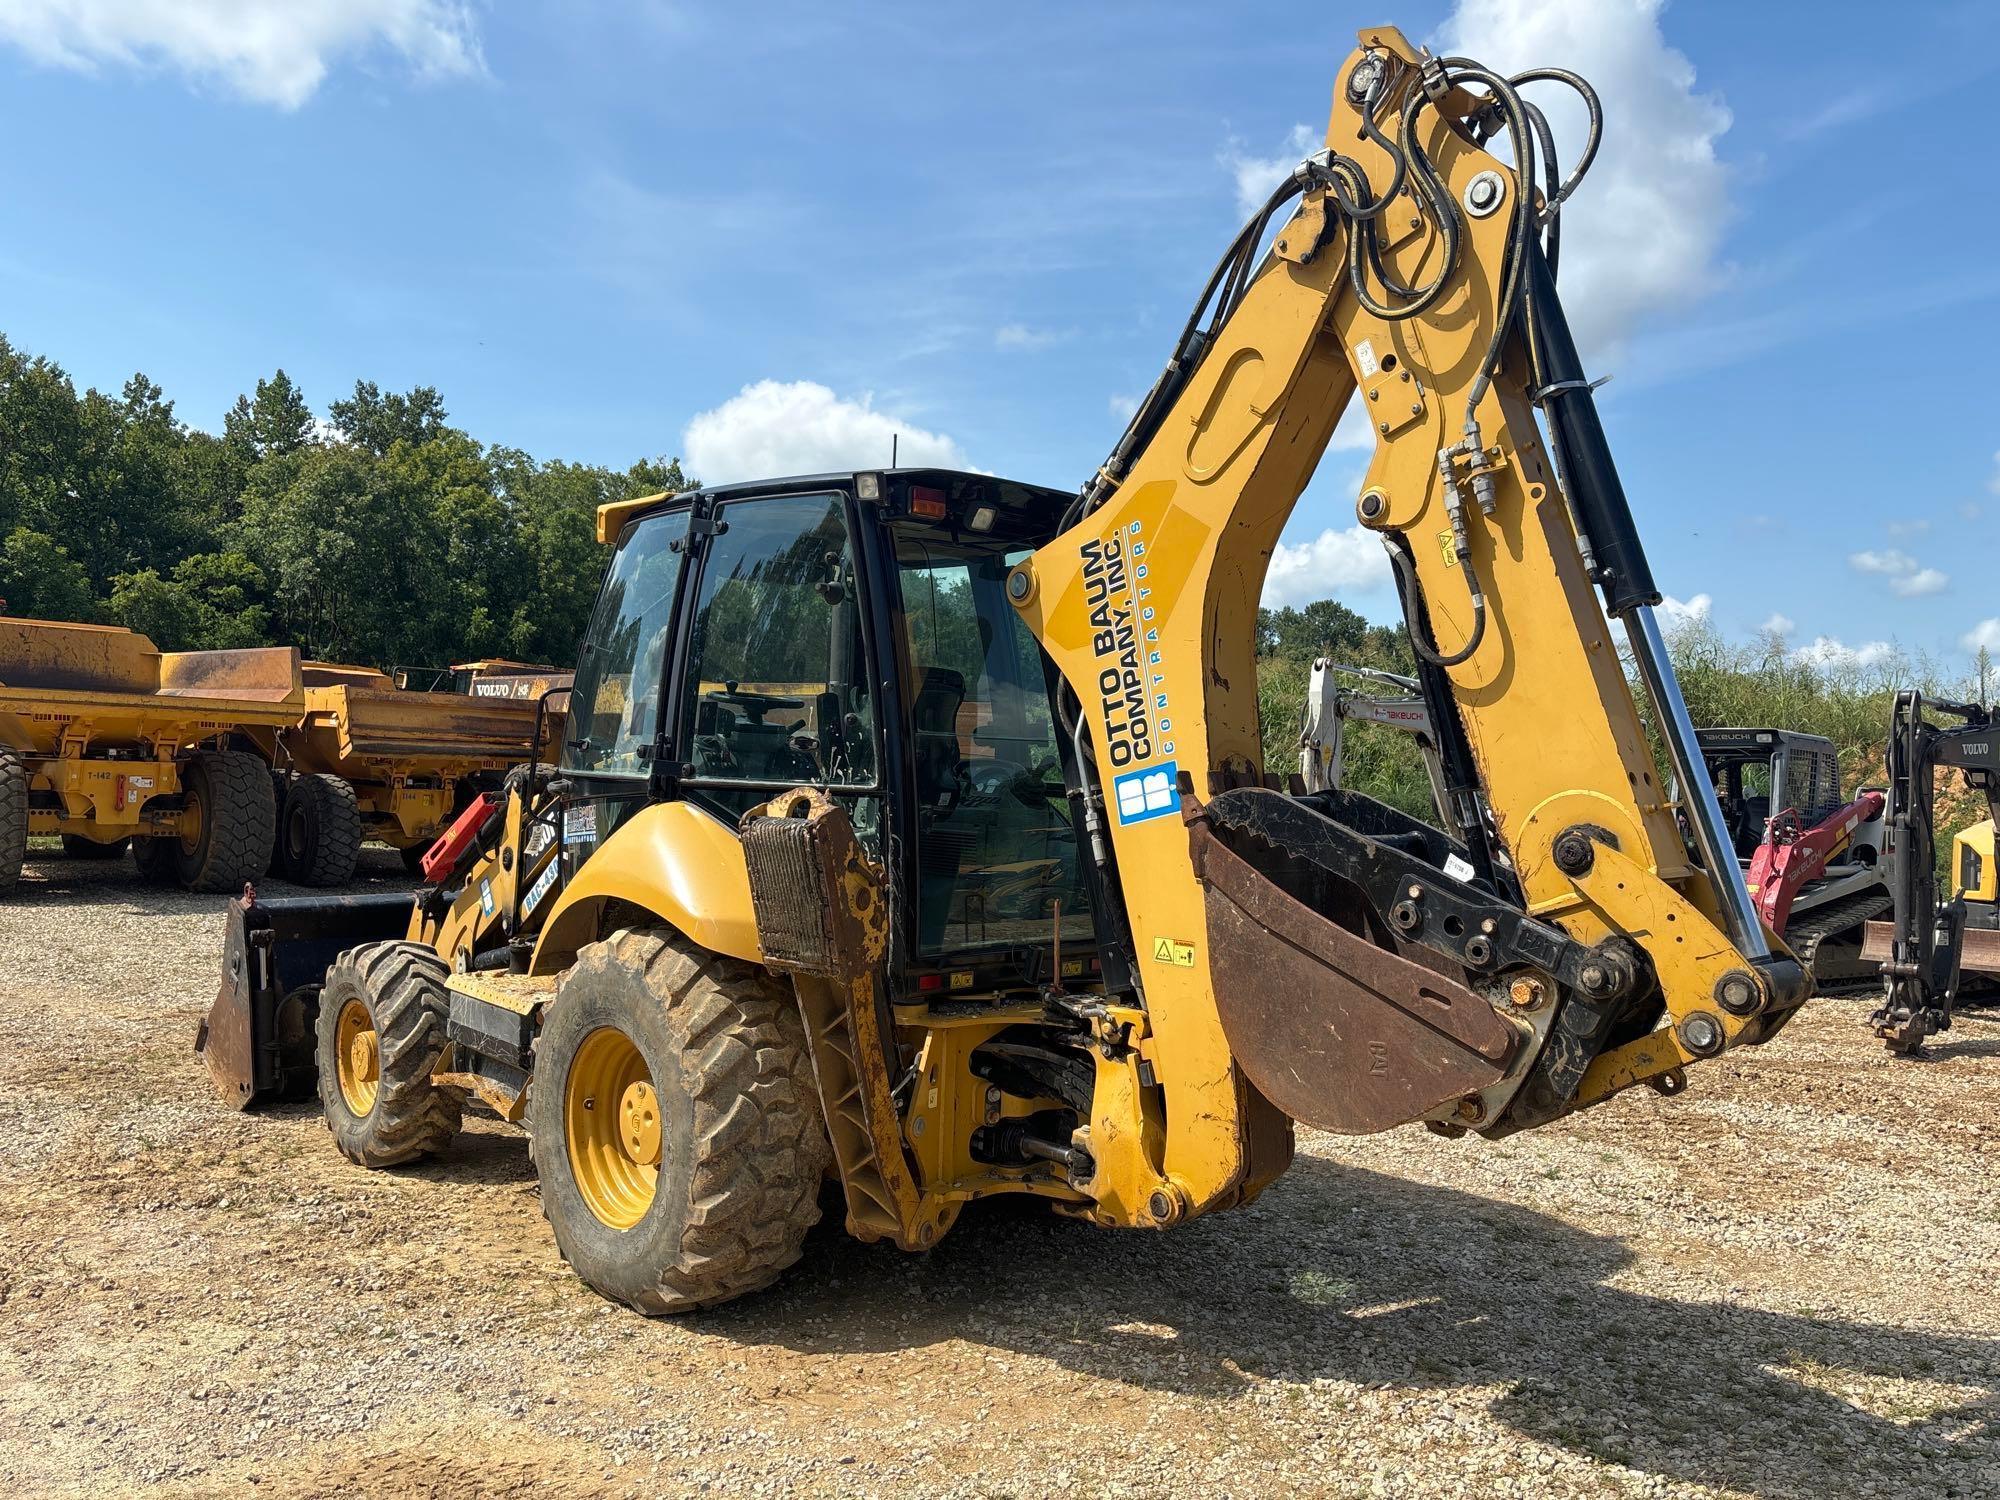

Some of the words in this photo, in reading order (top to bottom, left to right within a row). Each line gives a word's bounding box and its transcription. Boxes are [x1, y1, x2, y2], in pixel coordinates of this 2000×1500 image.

[1080, 538, 1114, 658] BAUM
[1103, 530, 1127, 594] INC.
[1112, 599, 1152, 761] COMPANY,
[1130, 520, 1174, 754] CONTRACTORS
[476, 684, 509, 697] VOLVO
[1099, 667, 1132, 767] OTTO
[1962, 743, 1989, 755] VOLVO
